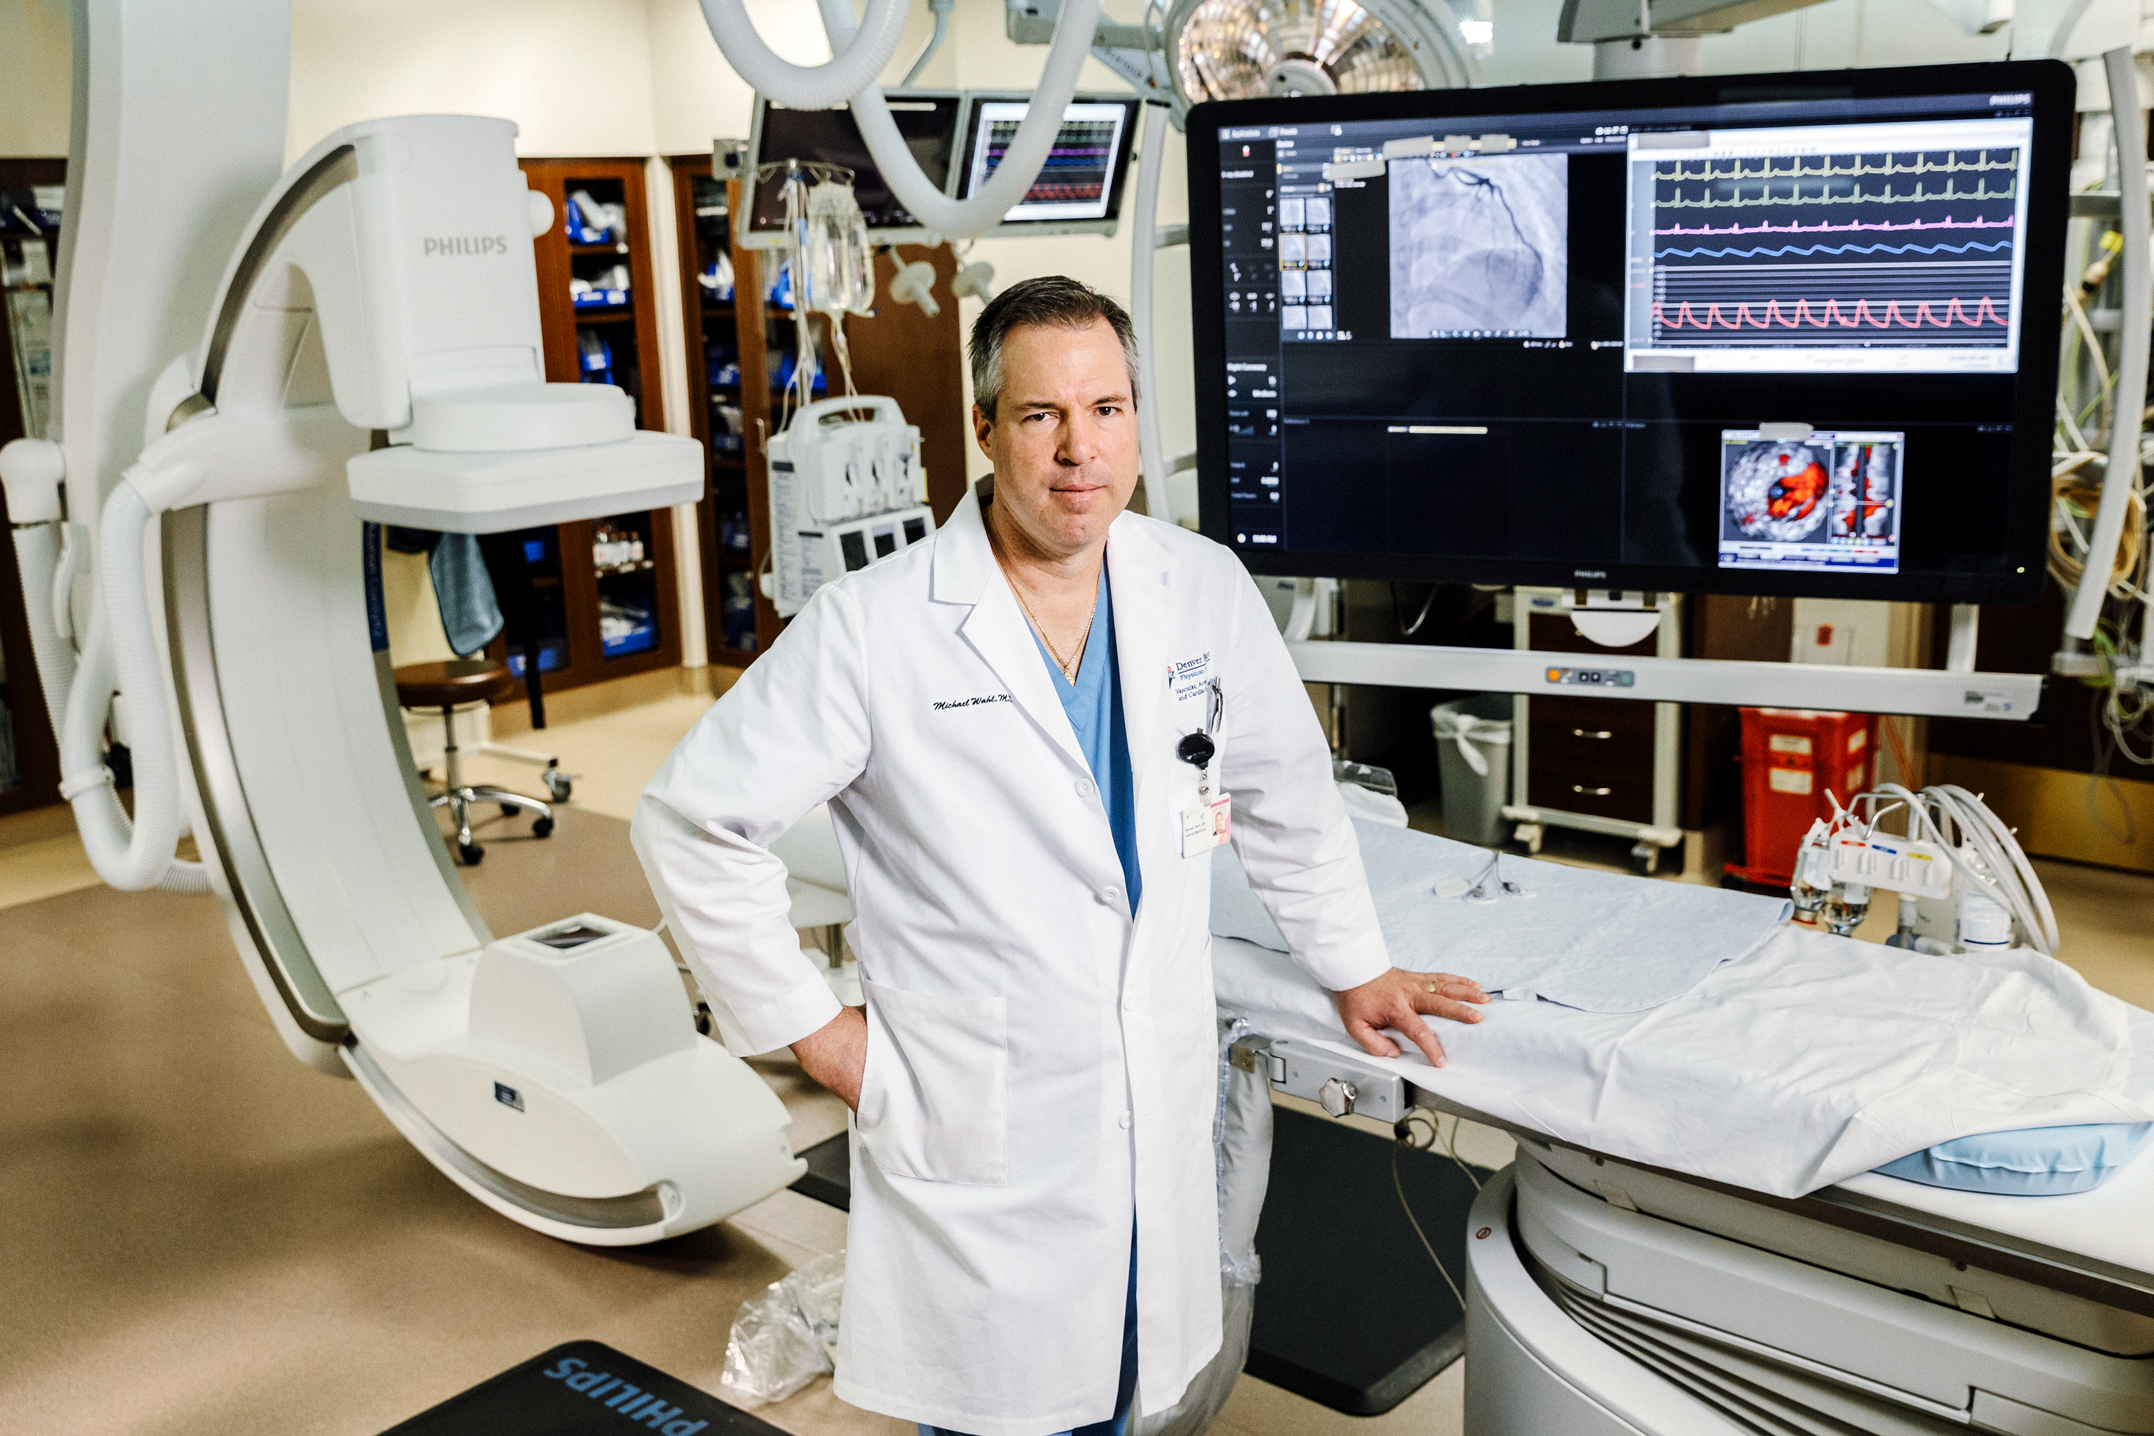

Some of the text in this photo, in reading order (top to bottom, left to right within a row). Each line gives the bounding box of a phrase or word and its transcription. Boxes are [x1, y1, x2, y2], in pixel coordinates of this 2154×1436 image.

[424, 236, 507, 256] PHILIPS
[1574, 570, 1606, 579] PHILIPS
[1175, 657, 1202, 671] Denver
[933, 699, 970, 710] Michael
[543, 1357, 710, 1436] PHILIPS
